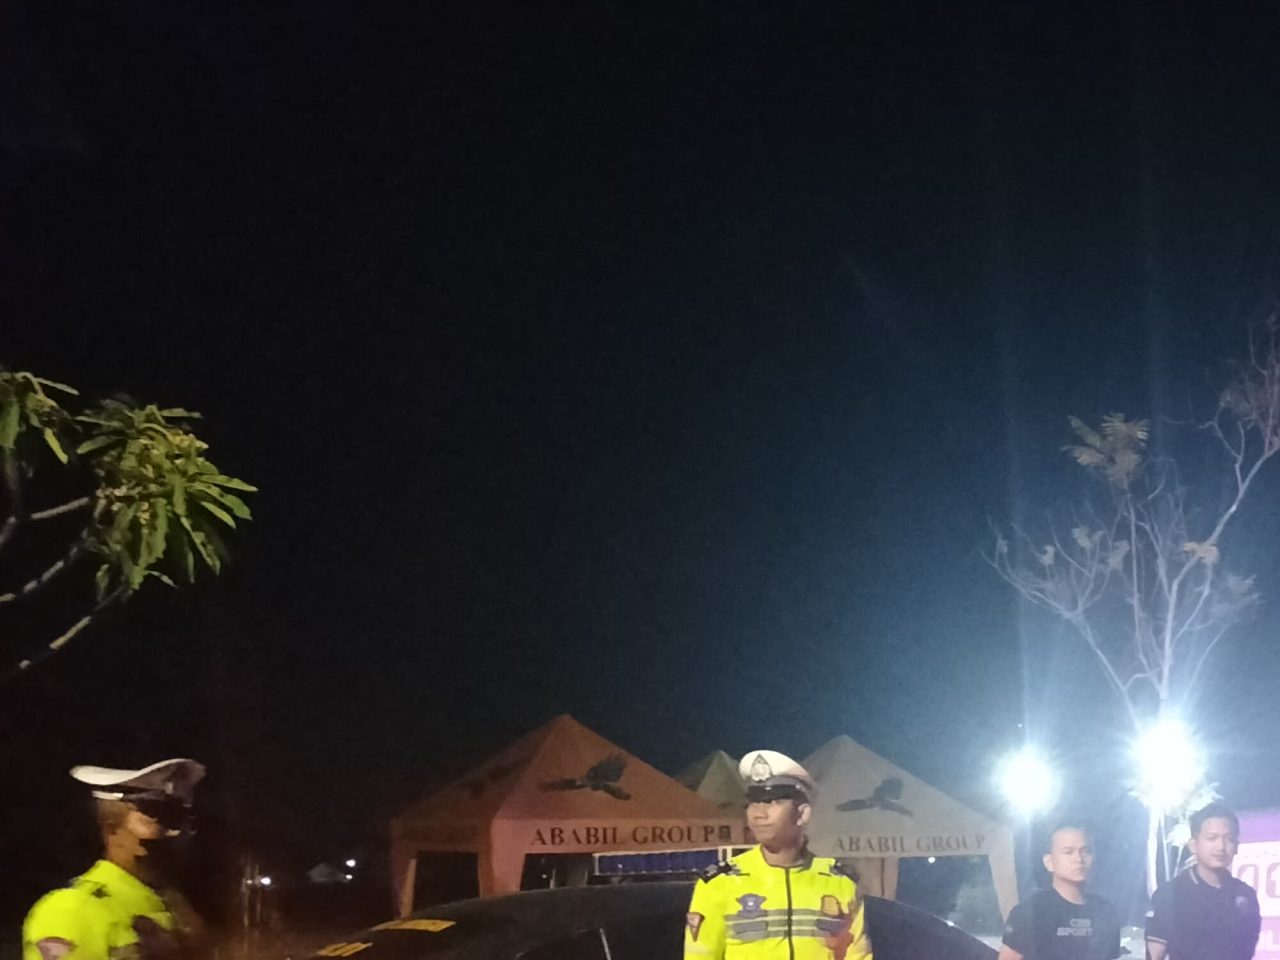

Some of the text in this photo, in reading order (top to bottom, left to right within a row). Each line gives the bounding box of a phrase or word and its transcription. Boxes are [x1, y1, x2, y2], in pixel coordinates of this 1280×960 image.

[531, 824, 715, 846] ABABIL GROUP
[834, 834, 986, 853] ABABIL GROUP
